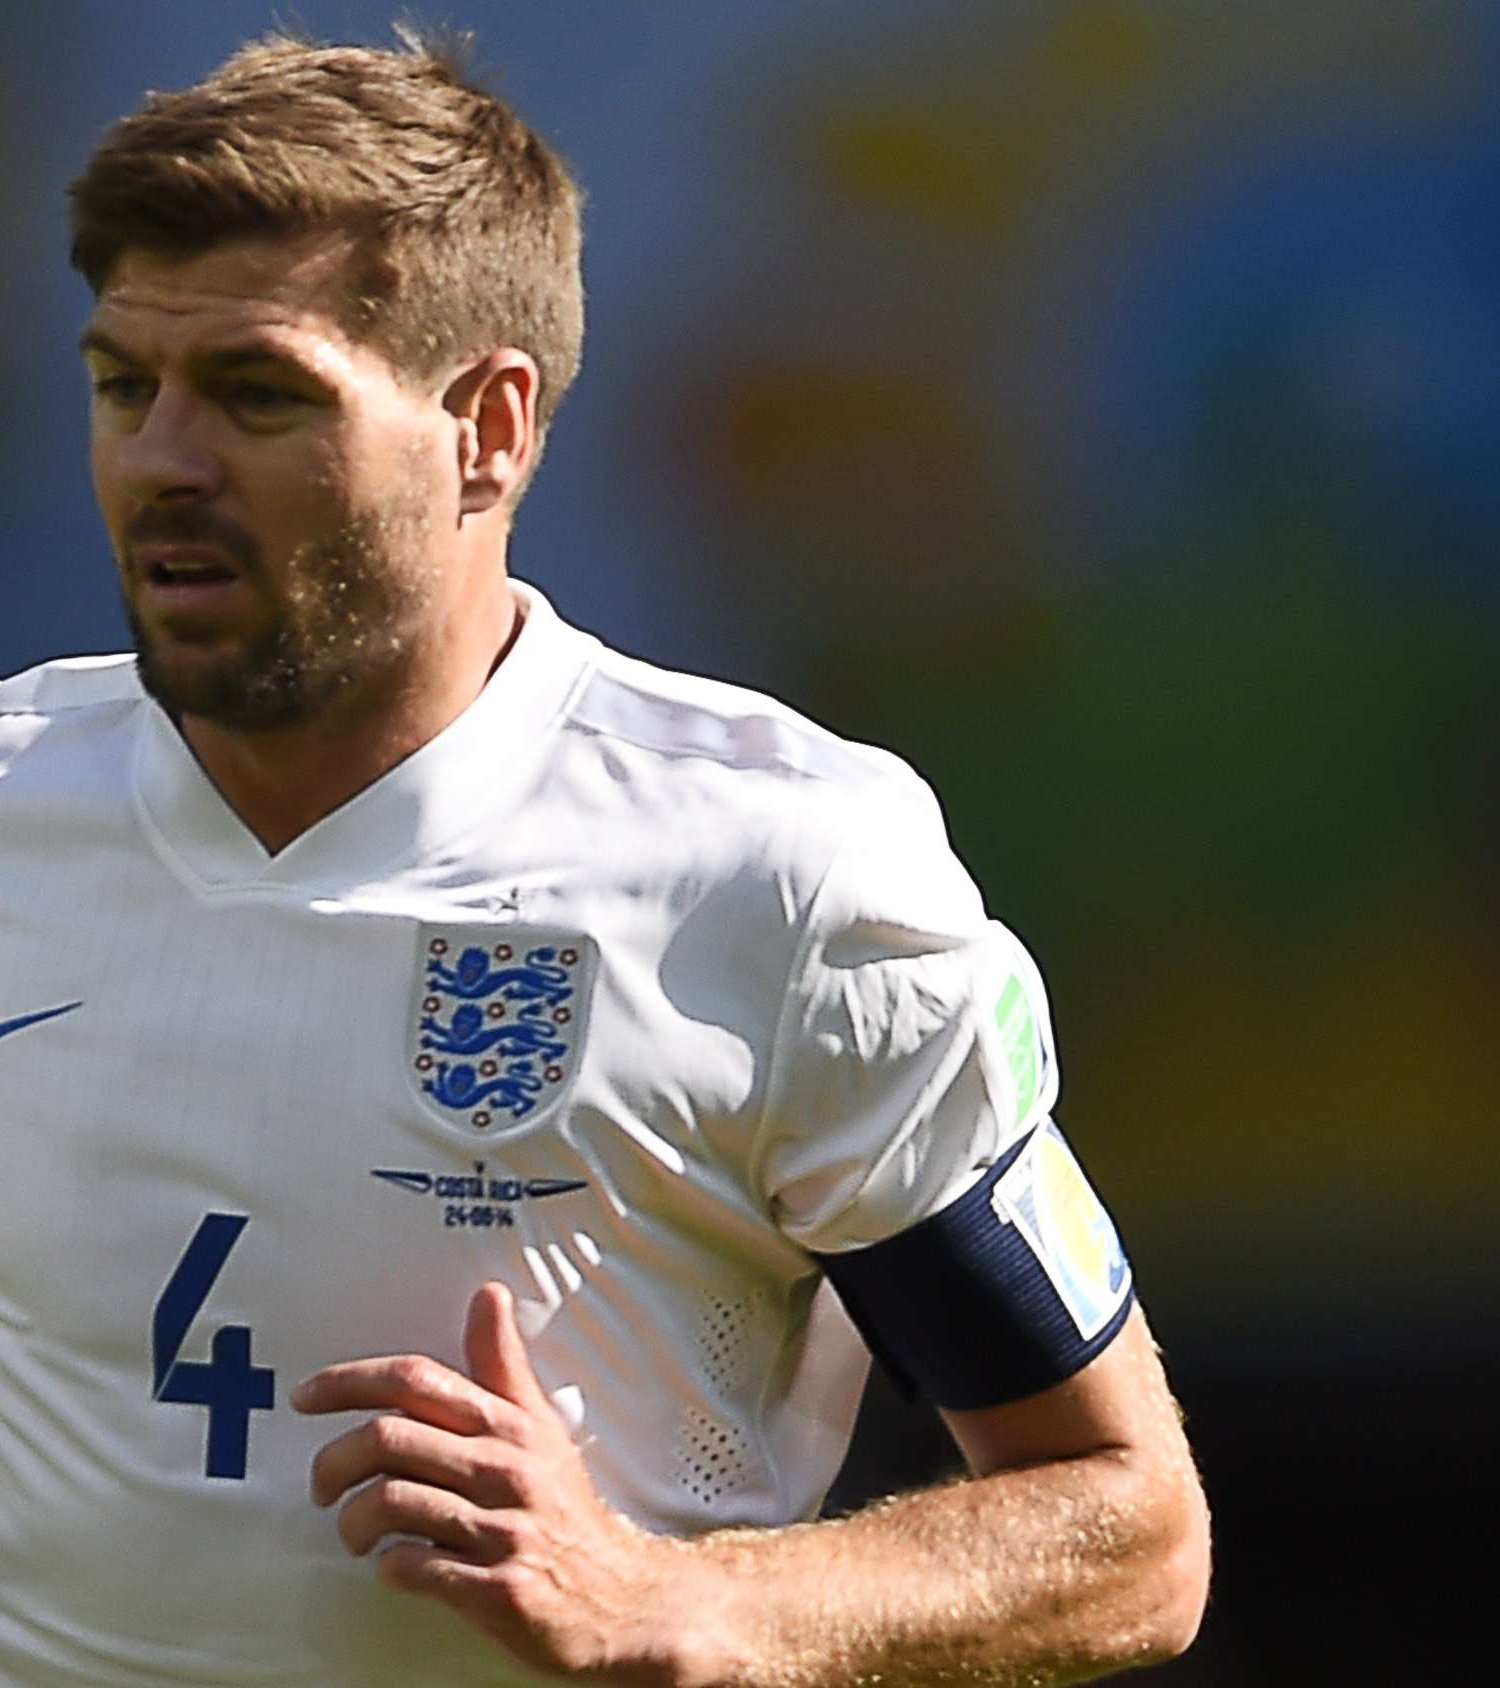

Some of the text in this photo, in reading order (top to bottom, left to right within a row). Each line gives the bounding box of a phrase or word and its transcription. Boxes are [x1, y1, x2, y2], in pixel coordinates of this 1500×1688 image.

[434, 1176, 523, 1201] COSTA RICA
[152, 1212, 275, 1480] 4
